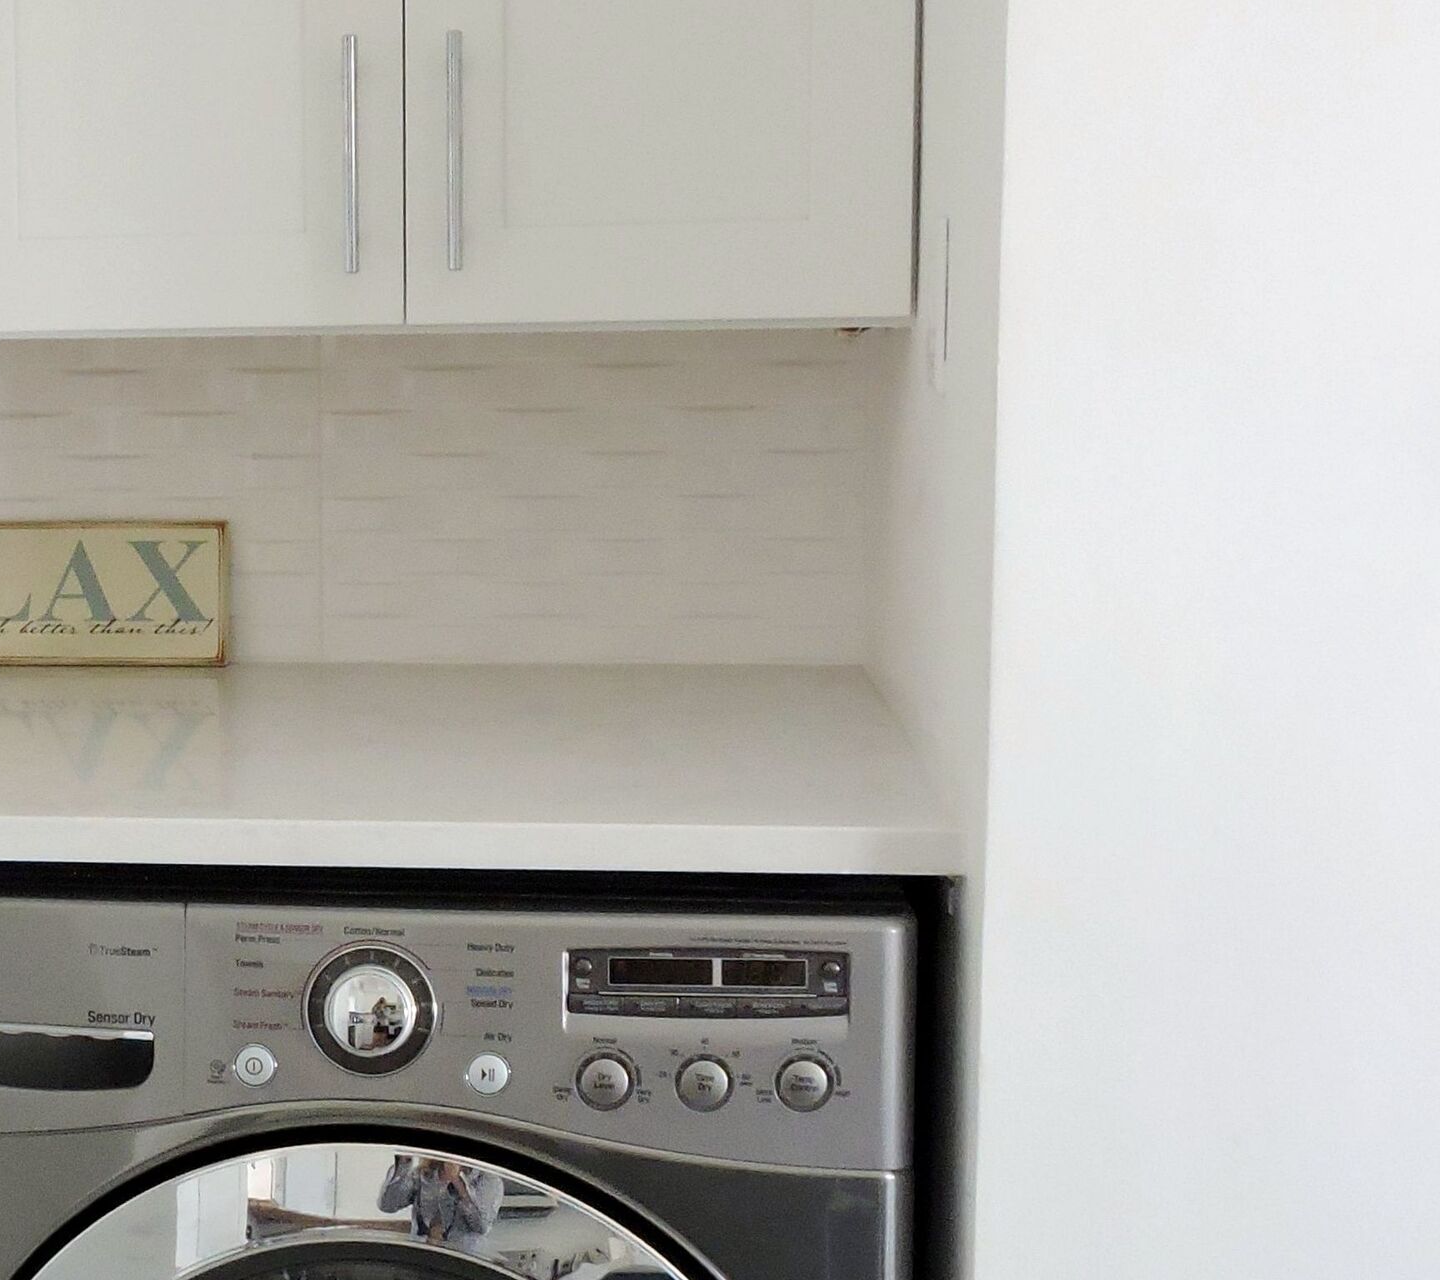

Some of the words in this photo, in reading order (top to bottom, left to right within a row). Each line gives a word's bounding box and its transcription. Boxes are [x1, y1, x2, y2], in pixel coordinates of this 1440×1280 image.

[19, 618, 77, 637] better
[89, 618, 143, 636] than
[87, 1010, 130, 1025] Sensor
[133, 1012, 156, 1027] Dry
